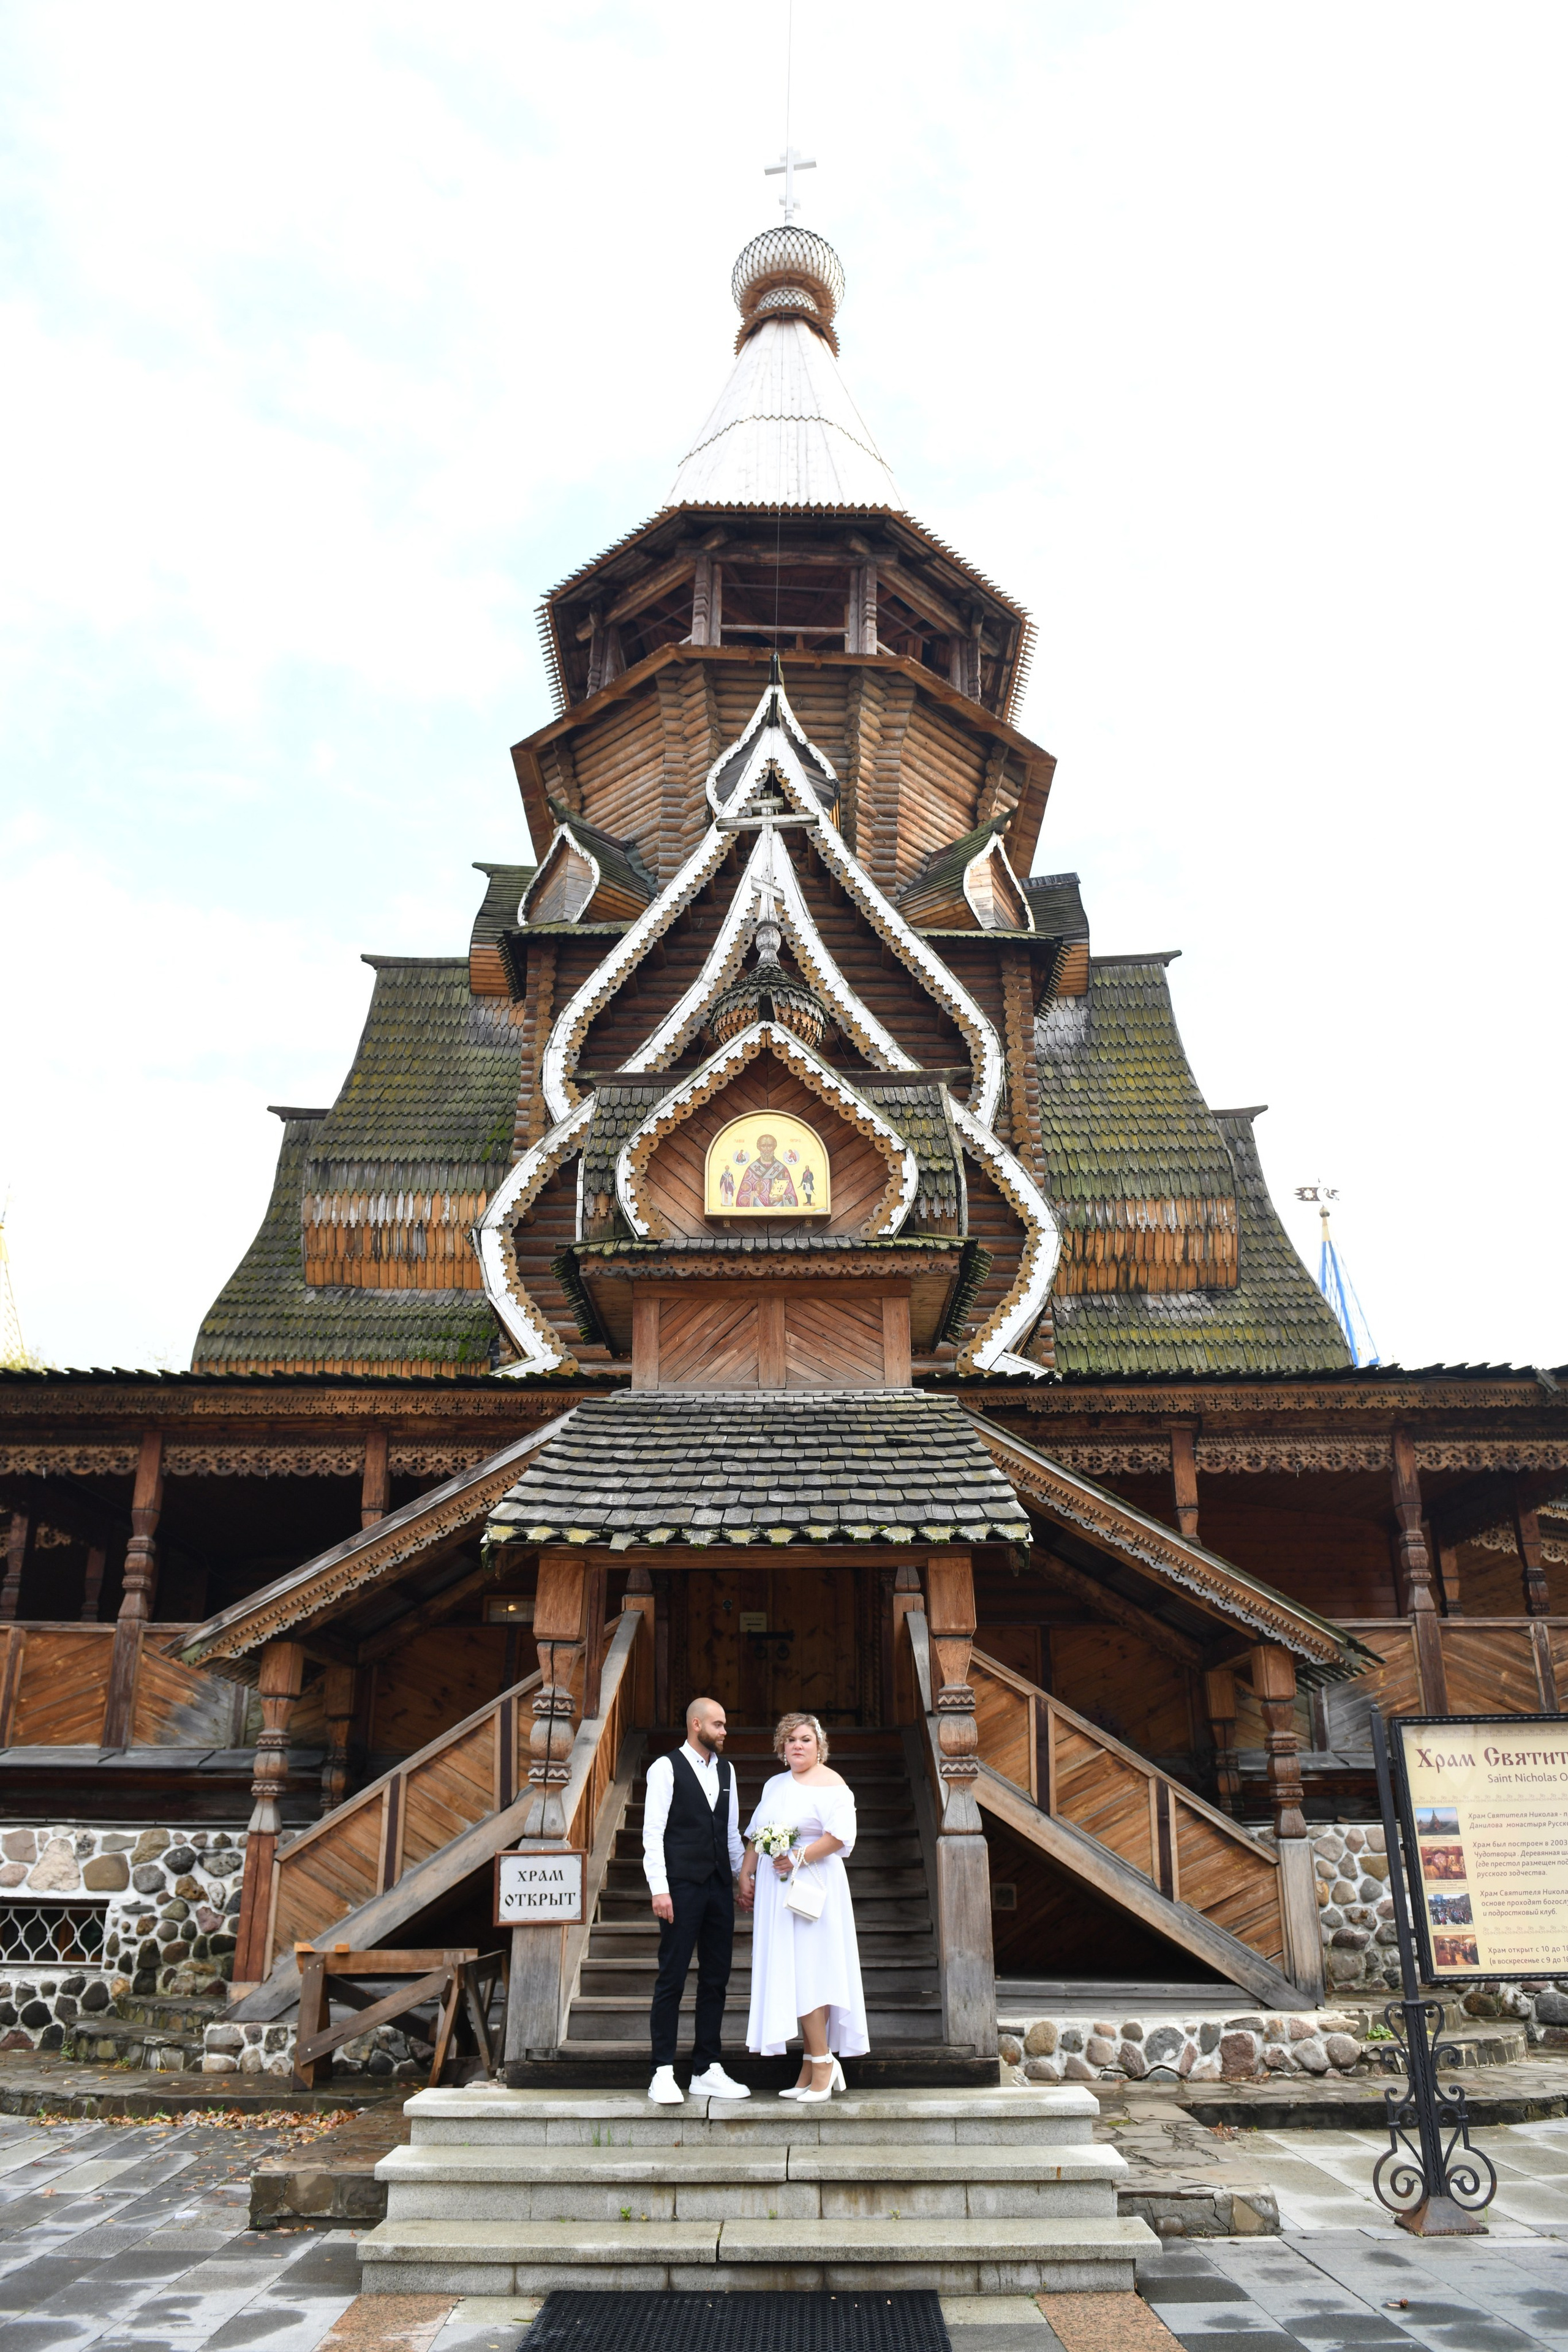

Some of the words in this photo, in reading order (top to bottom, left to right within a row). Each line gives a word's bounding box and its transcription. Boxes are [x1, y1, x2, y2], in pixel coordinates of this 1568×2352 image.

[1415, 1748, 1476, 1773] Храм
[1488, 1774, 1513, 1784] Saint
[1515, 1772, 1557, 1783] Nicholas
[517, 1870, 564, 1882] ХРАМ
[505, 1892, 576, 1907] ОТКРЫТ
[1507, 1899, 1541, 1907] проходят
[1488, 1909, 1539, 1918] подростковый
[1540, 1908, 1558, 1917] клуб.
[1490, 1957, 1496, 1966] (в
